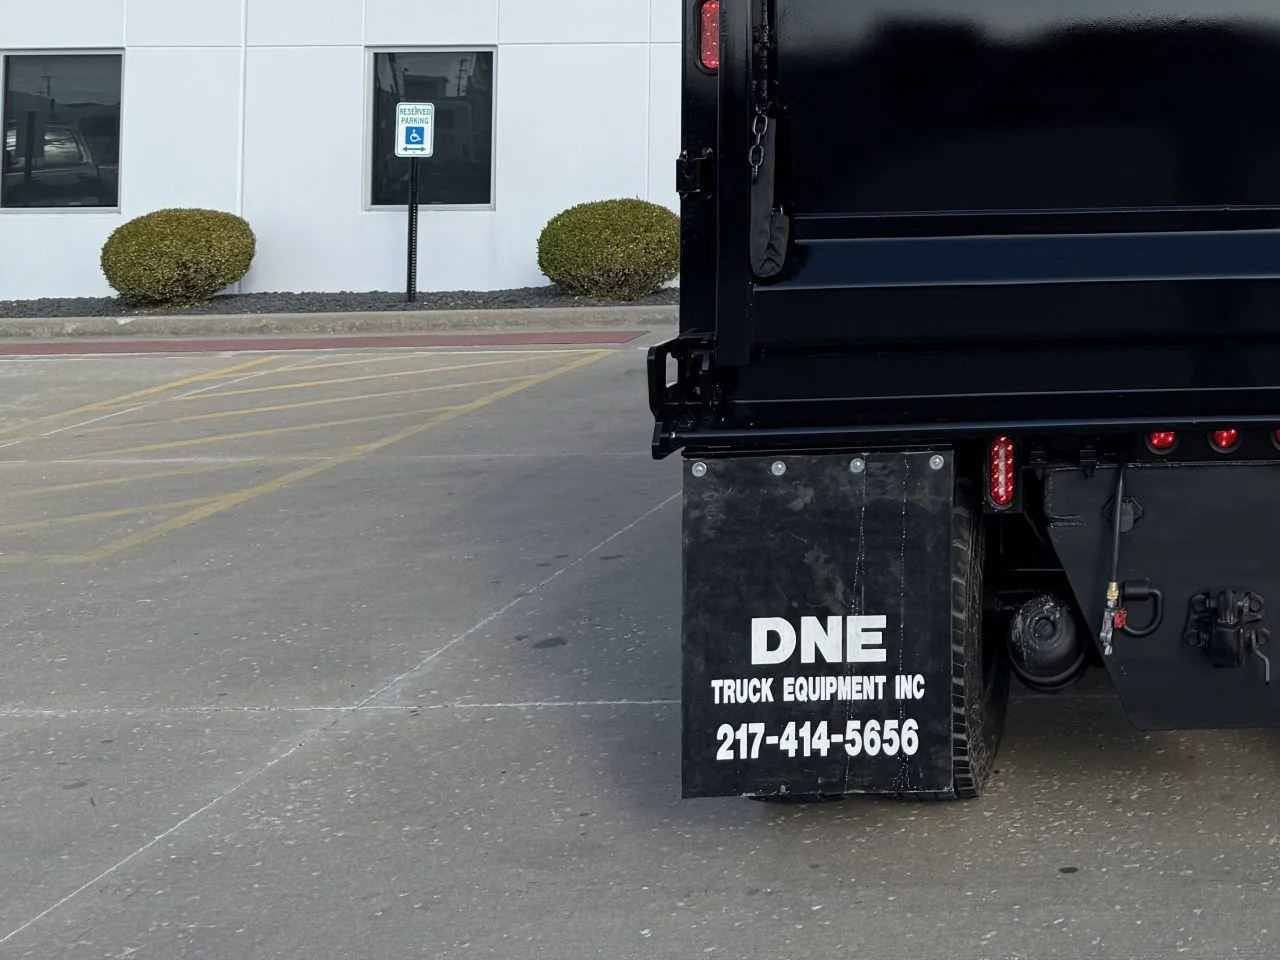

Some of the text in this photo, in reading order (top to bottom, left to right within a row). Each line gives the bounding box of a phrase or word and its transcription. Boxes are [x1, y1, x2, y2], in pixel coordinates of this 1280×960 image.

[399, 107, 431, 116] RESERVED
[401, 116, 429, 125] PARKING
[751, 614, 887, 665] DNE
[711, 673, 926, 705] TRUCK EQUIPMENT INC
[716, 718, 920, 761] 217-414-5656
